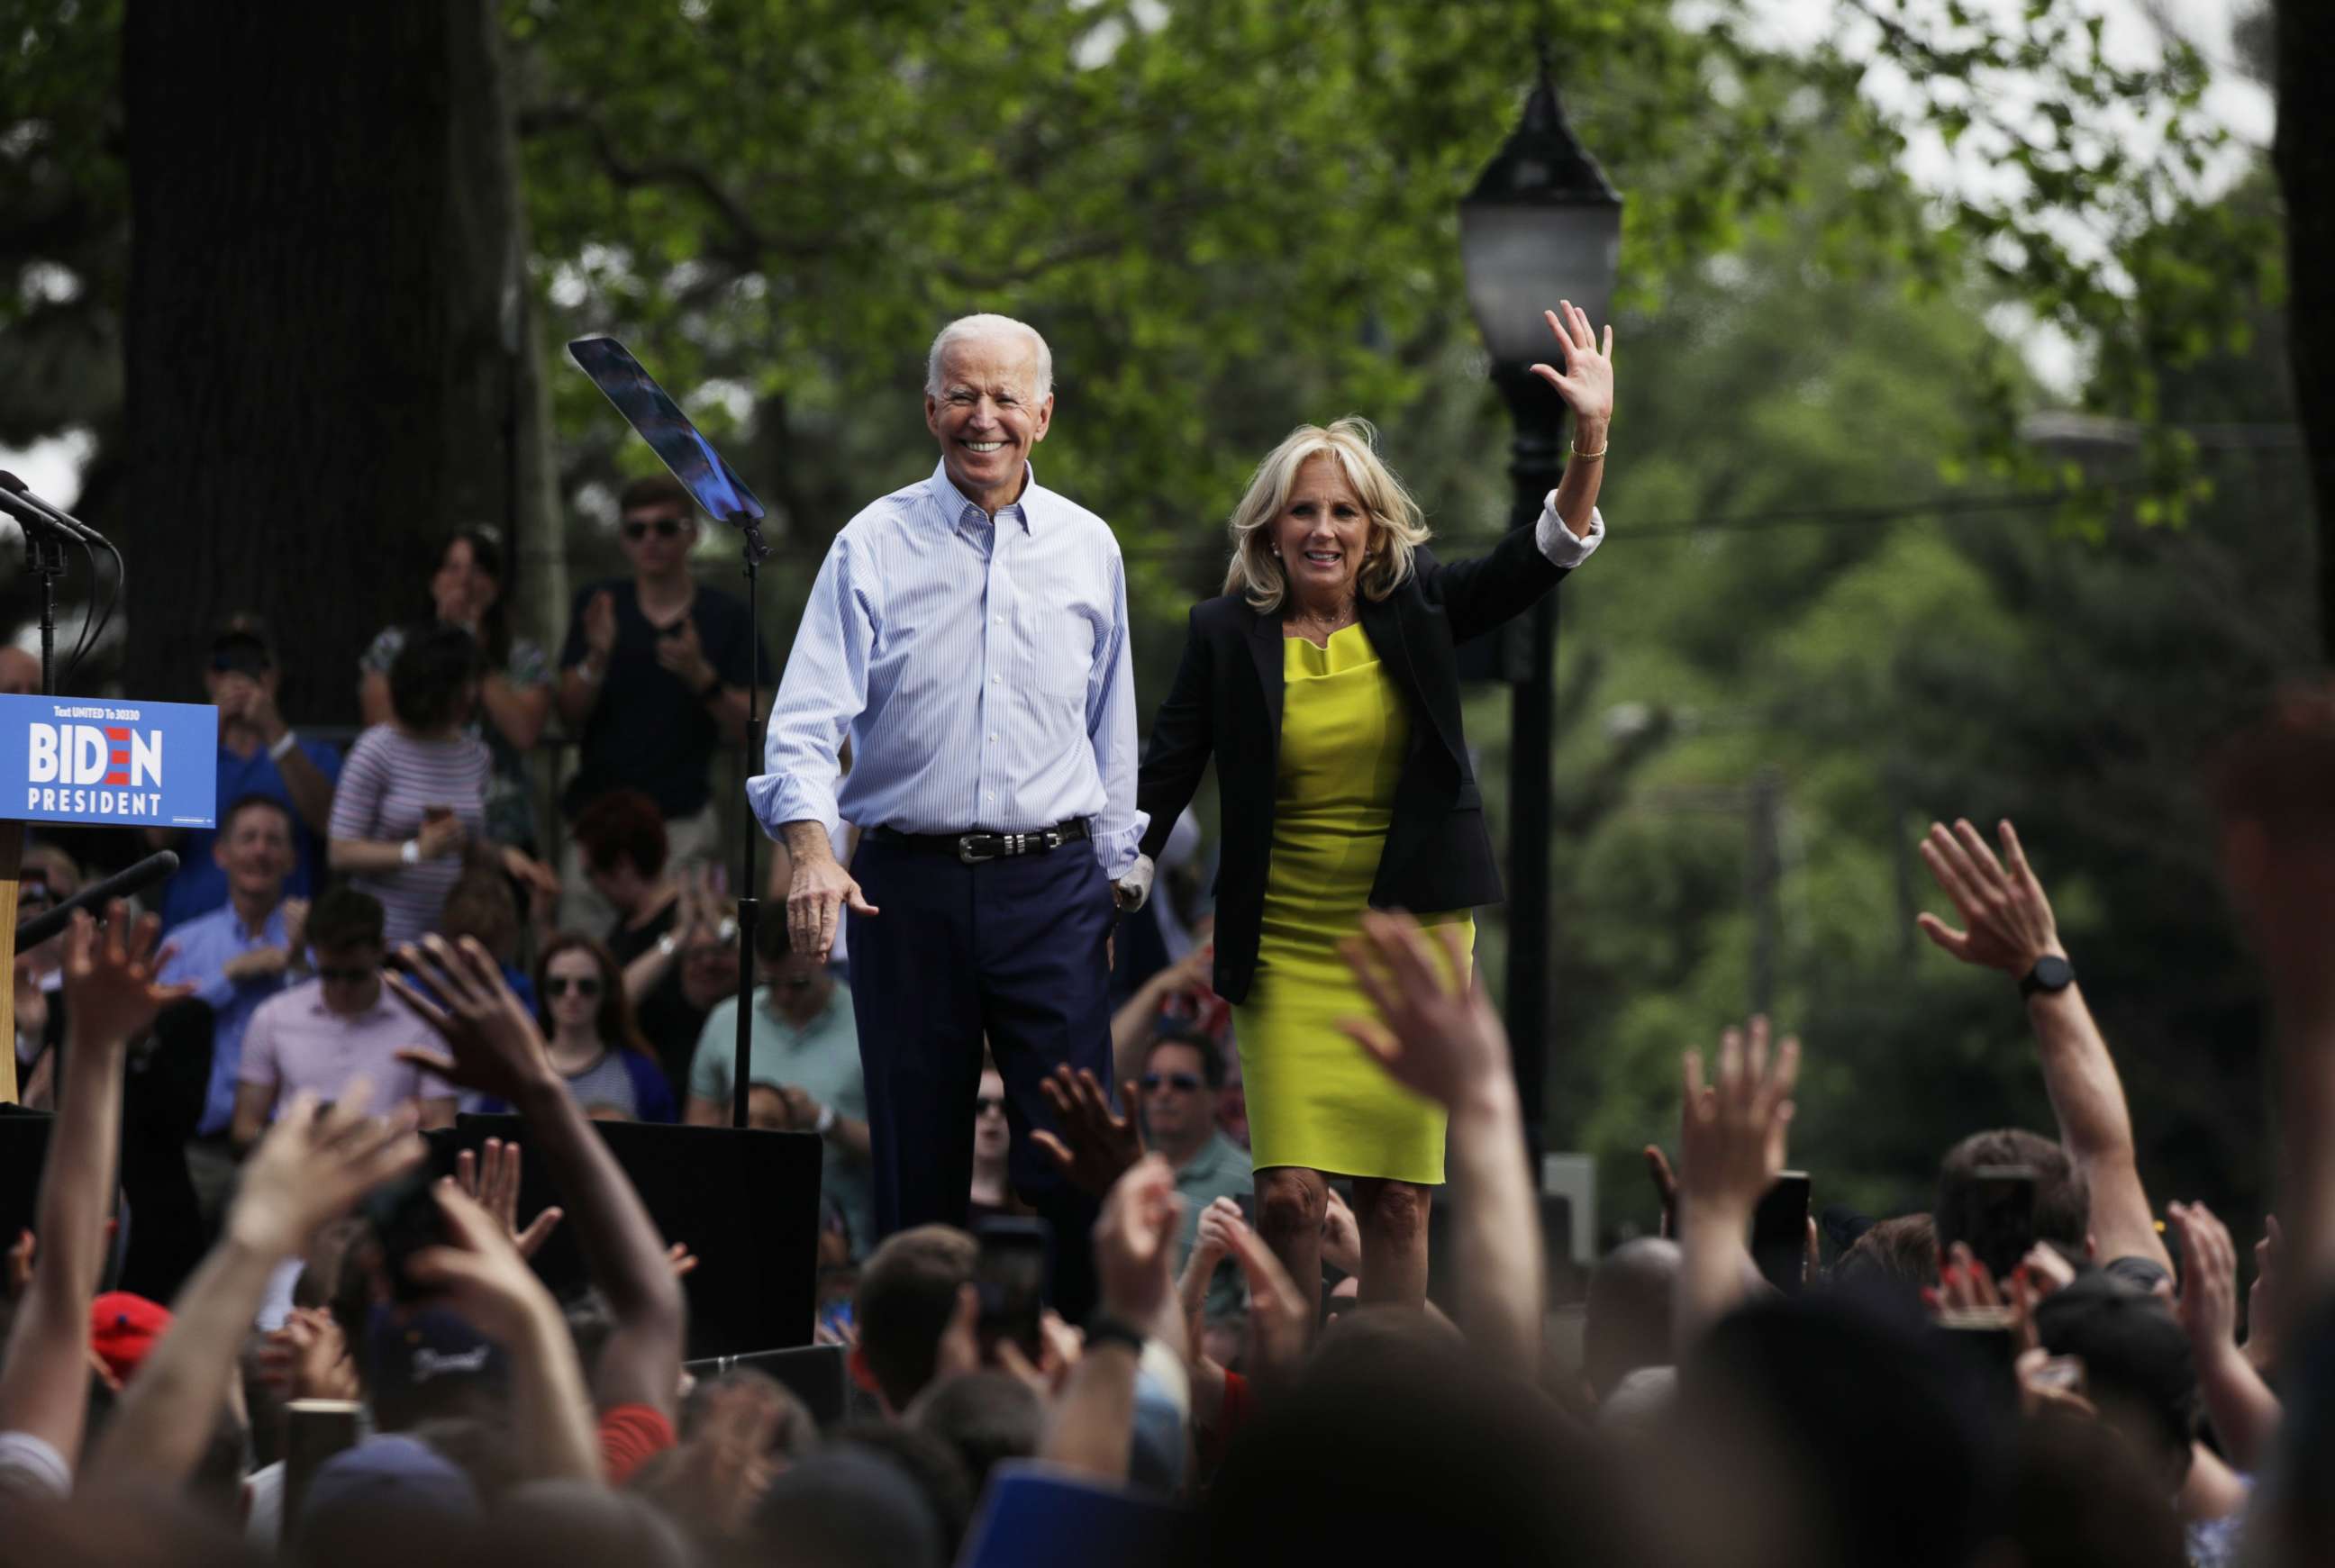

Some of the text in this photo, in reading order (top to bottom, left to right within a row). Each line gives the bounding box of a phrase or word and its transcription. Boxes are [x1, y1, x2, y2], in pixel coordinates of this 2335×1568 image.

[54, 705, 141, 721] Text UNITED To 30330
[29, 722, 162, 787] BIDEN
[28, 788, 161, 816] PRESIDENT
